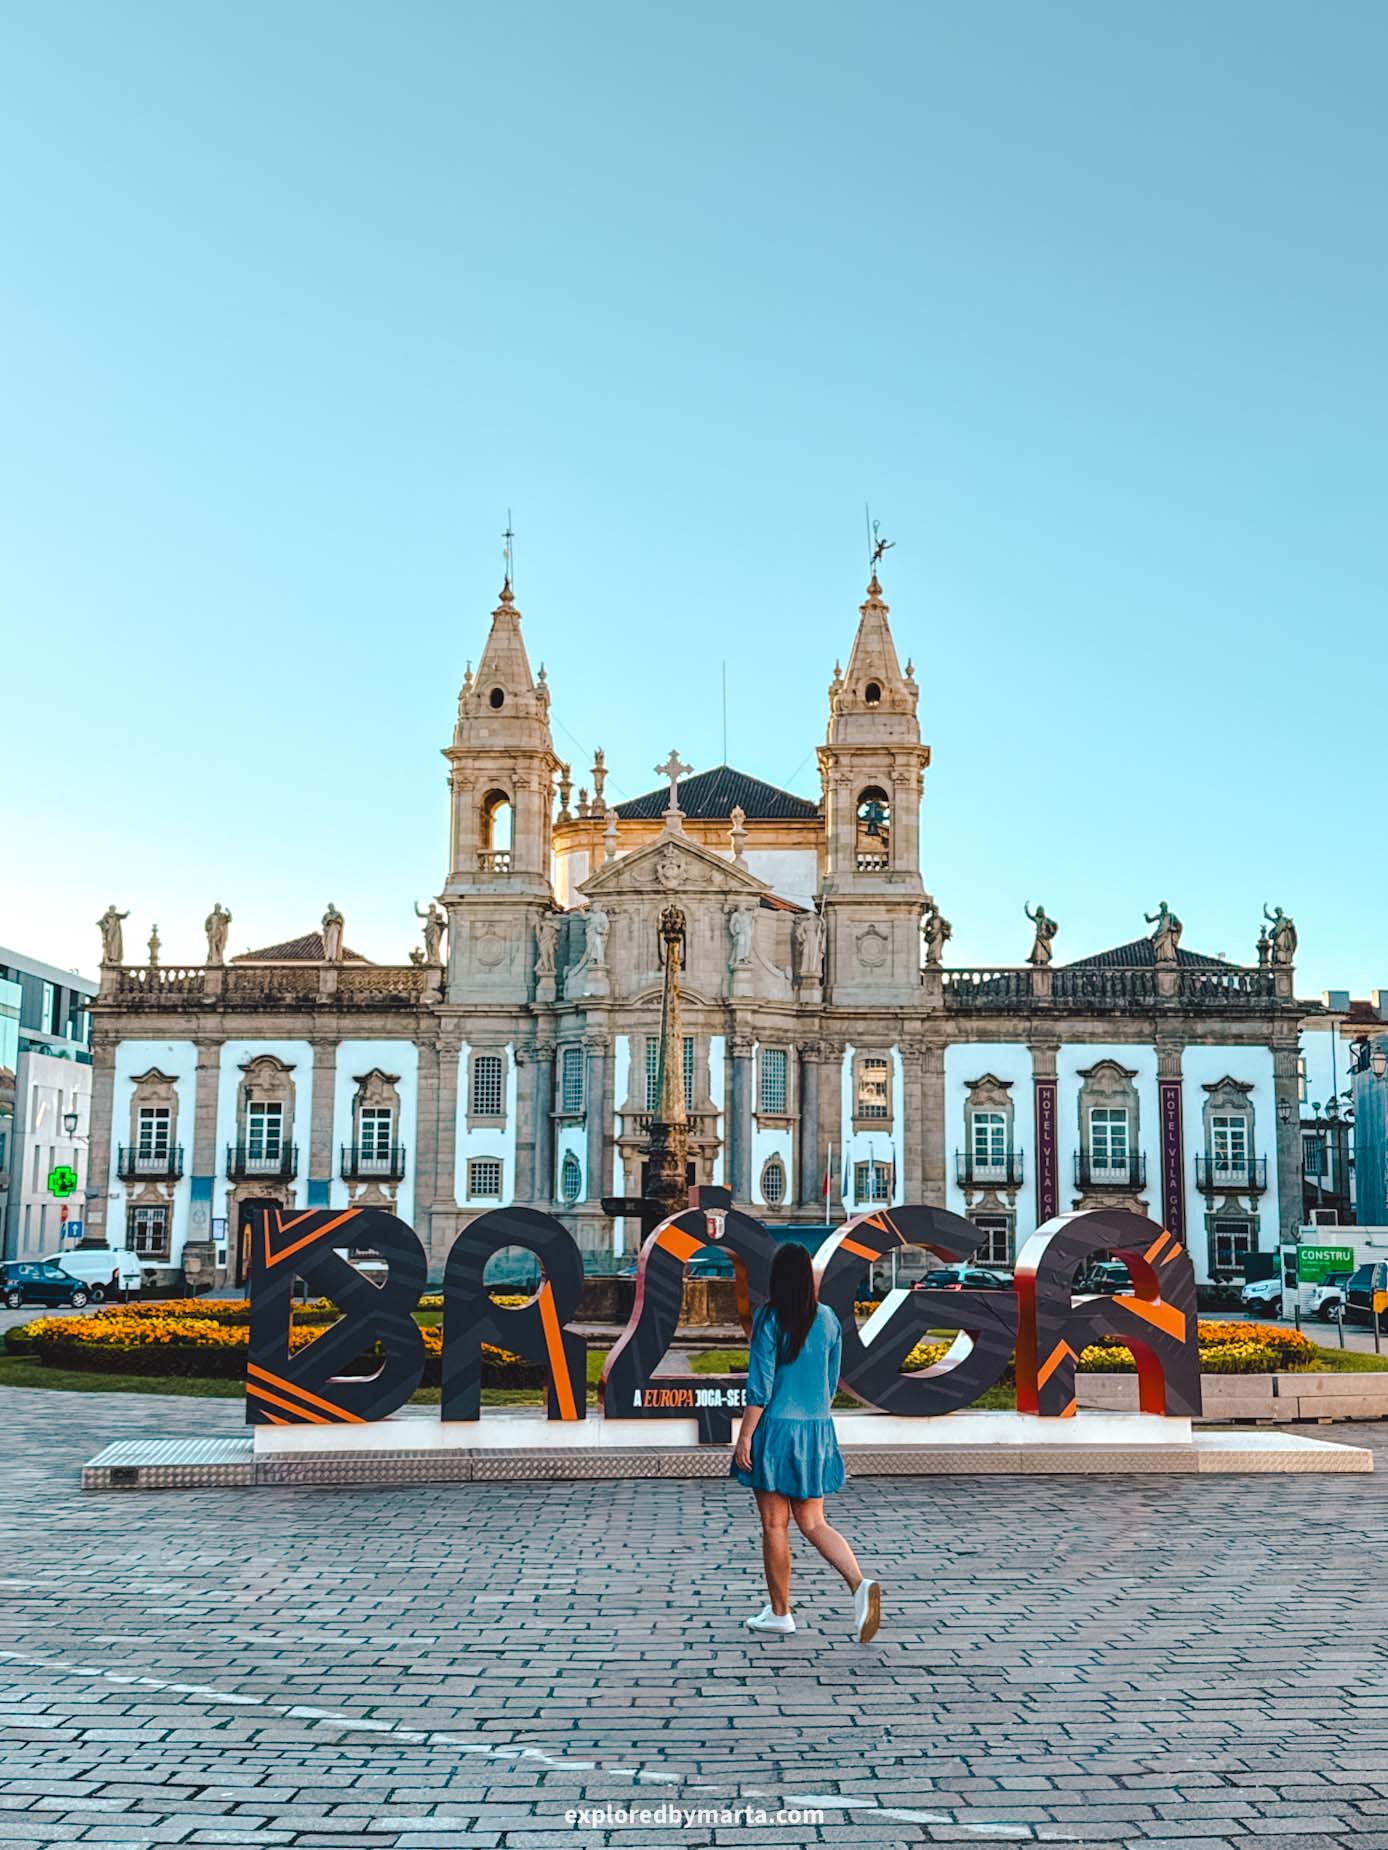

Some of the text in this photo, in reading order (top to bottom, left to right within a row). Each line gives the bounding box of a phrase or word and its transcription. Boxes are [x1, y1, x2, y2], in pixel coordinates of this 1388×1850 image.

[1042, 1090, 1051, 1140] HOTEL
[1166, 1090, 1175, 1141] HOTEL
[1043, 1147, 1052, 1186] VILA
[1168, 1148, 1177, 1187] VILA
[1301, 1249, 1351, 1261] CONSTRU
[633, 1388, 747, 1408] A EUROPA JOGA-SE E
